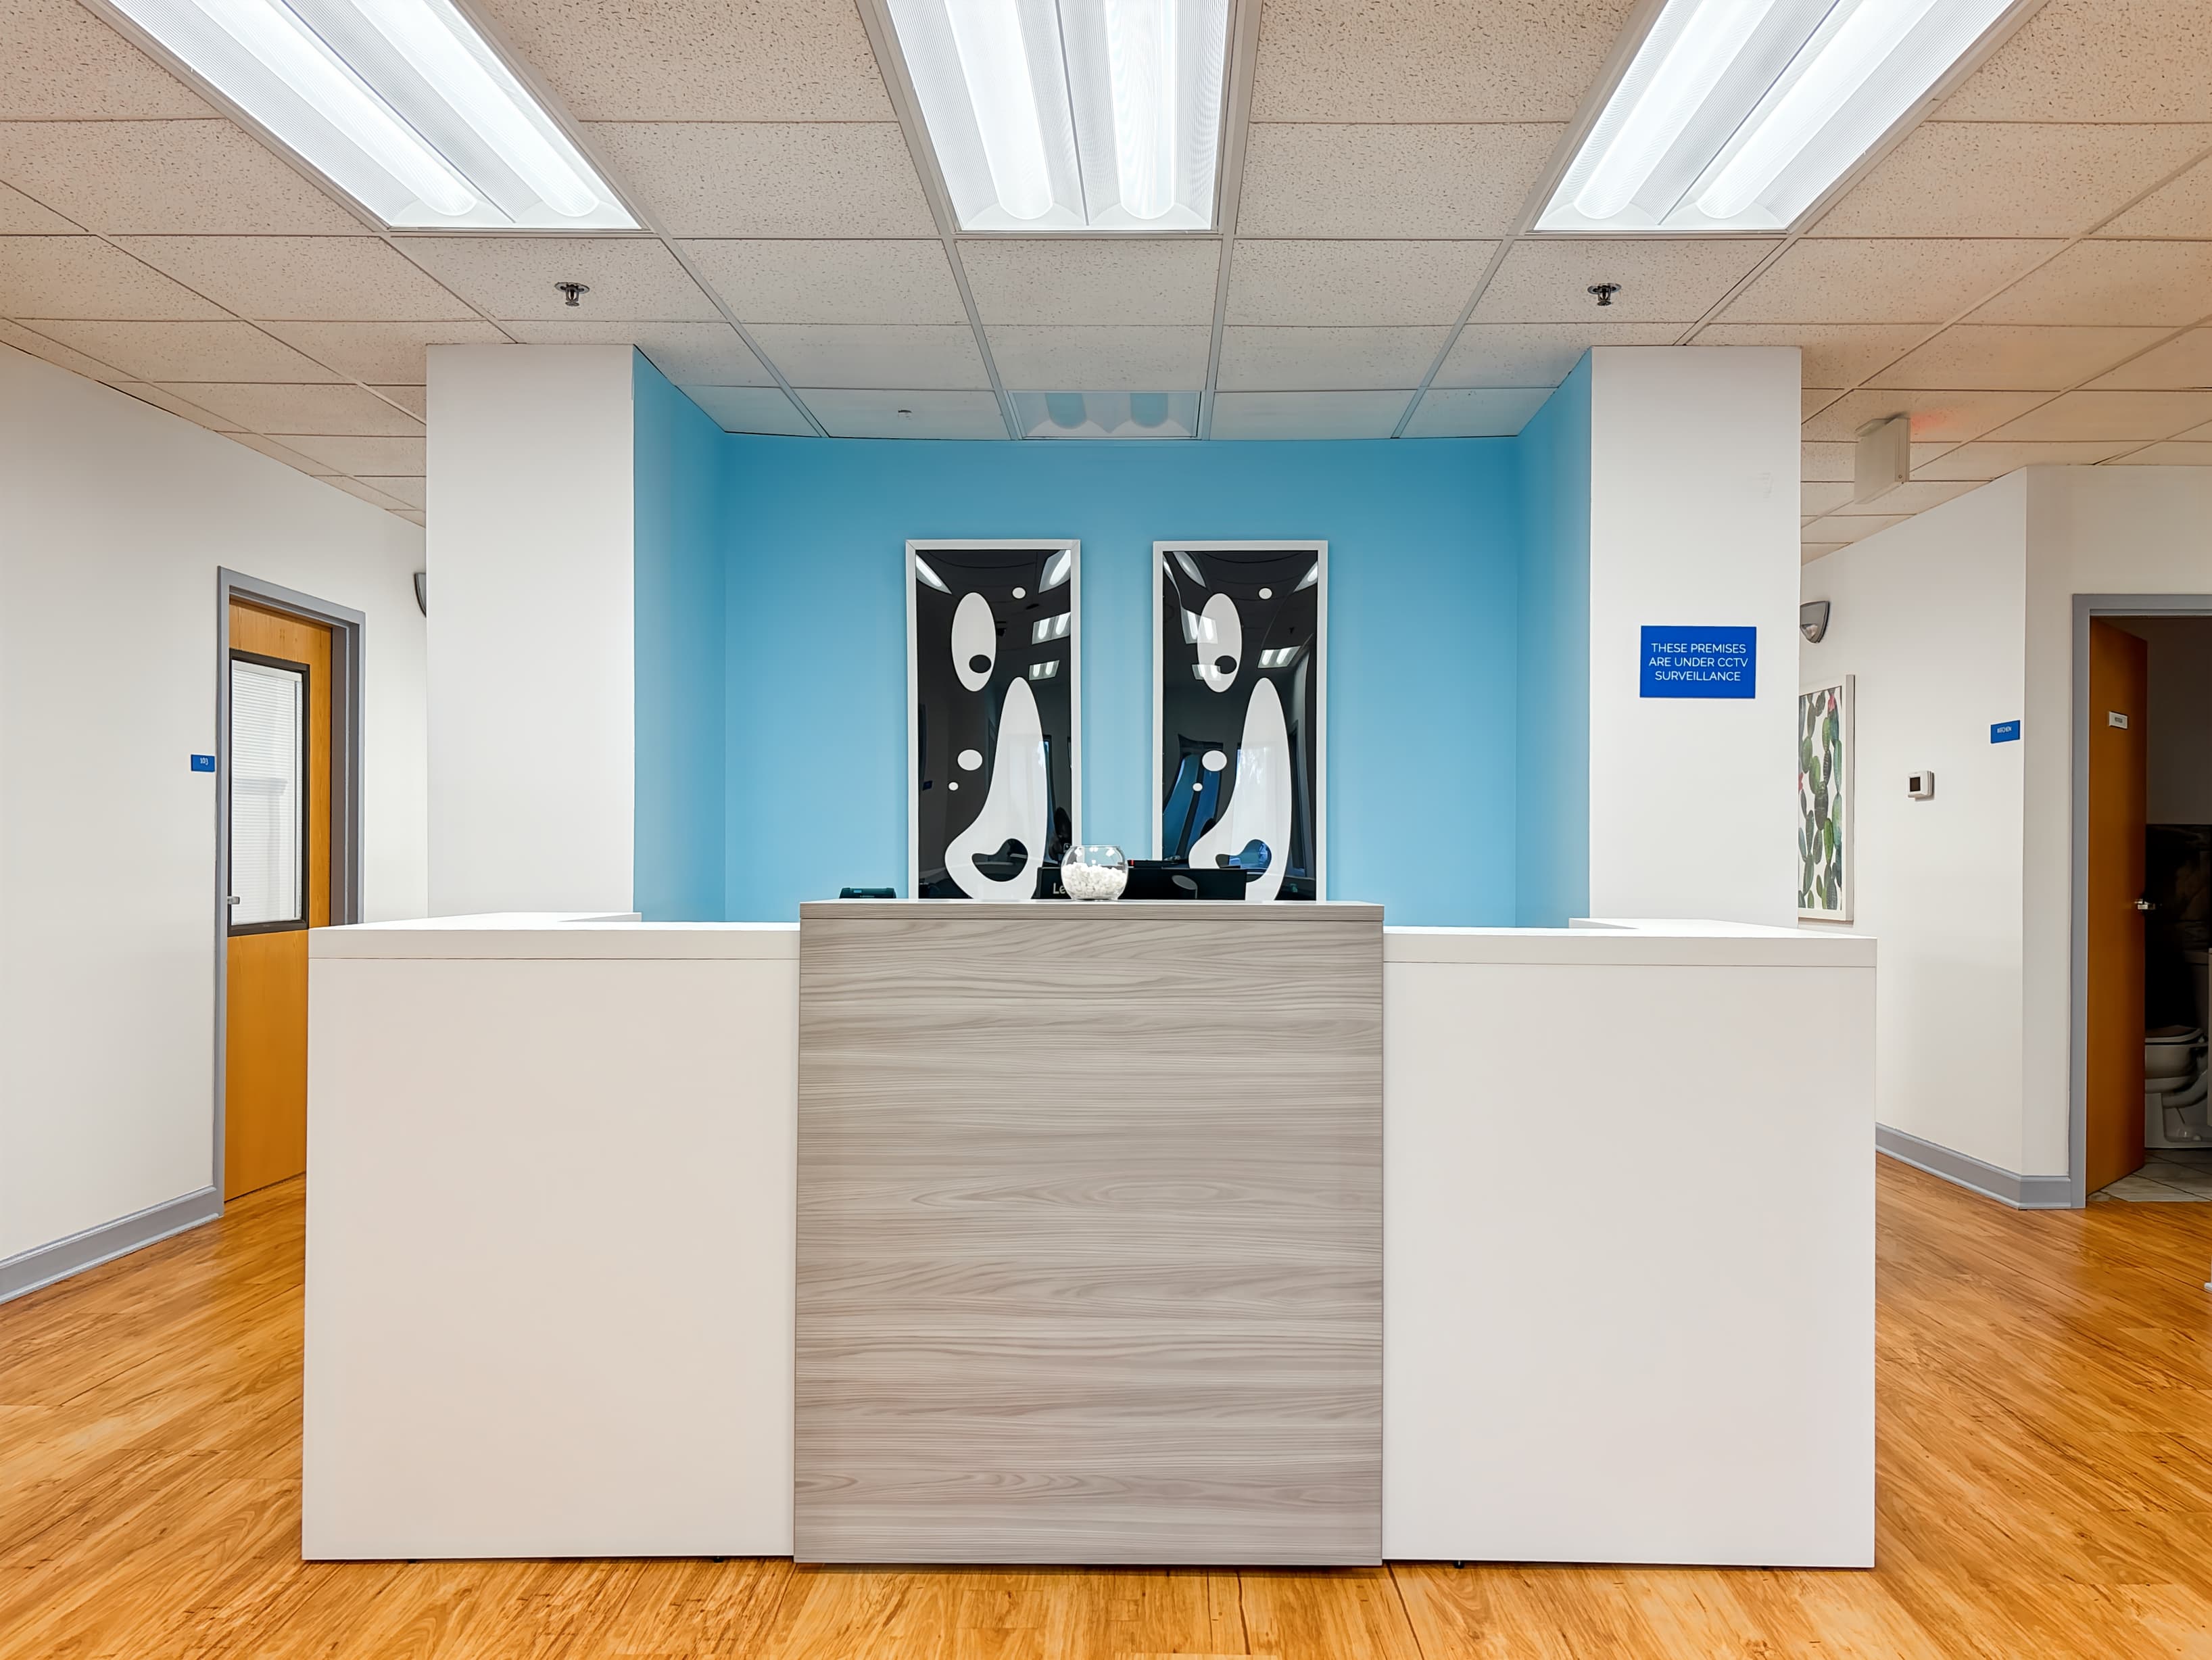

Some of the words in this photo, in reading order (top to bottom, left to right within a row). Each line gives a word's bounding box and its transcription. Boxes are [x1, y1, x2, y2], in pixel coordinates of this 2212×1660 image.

[1651, 643, 1688, 653] THESE
[1691, 643, 1746, 654] PREMISES
[1648, 657, 1672, 667] ARE
[1674, 657, 1715, 667] UNDER
[1717, 657, 1748, 667] CCTV
[1654, 671, 1741, 682] SURVEILLANCE
[199, 757, 209, 765] 103
